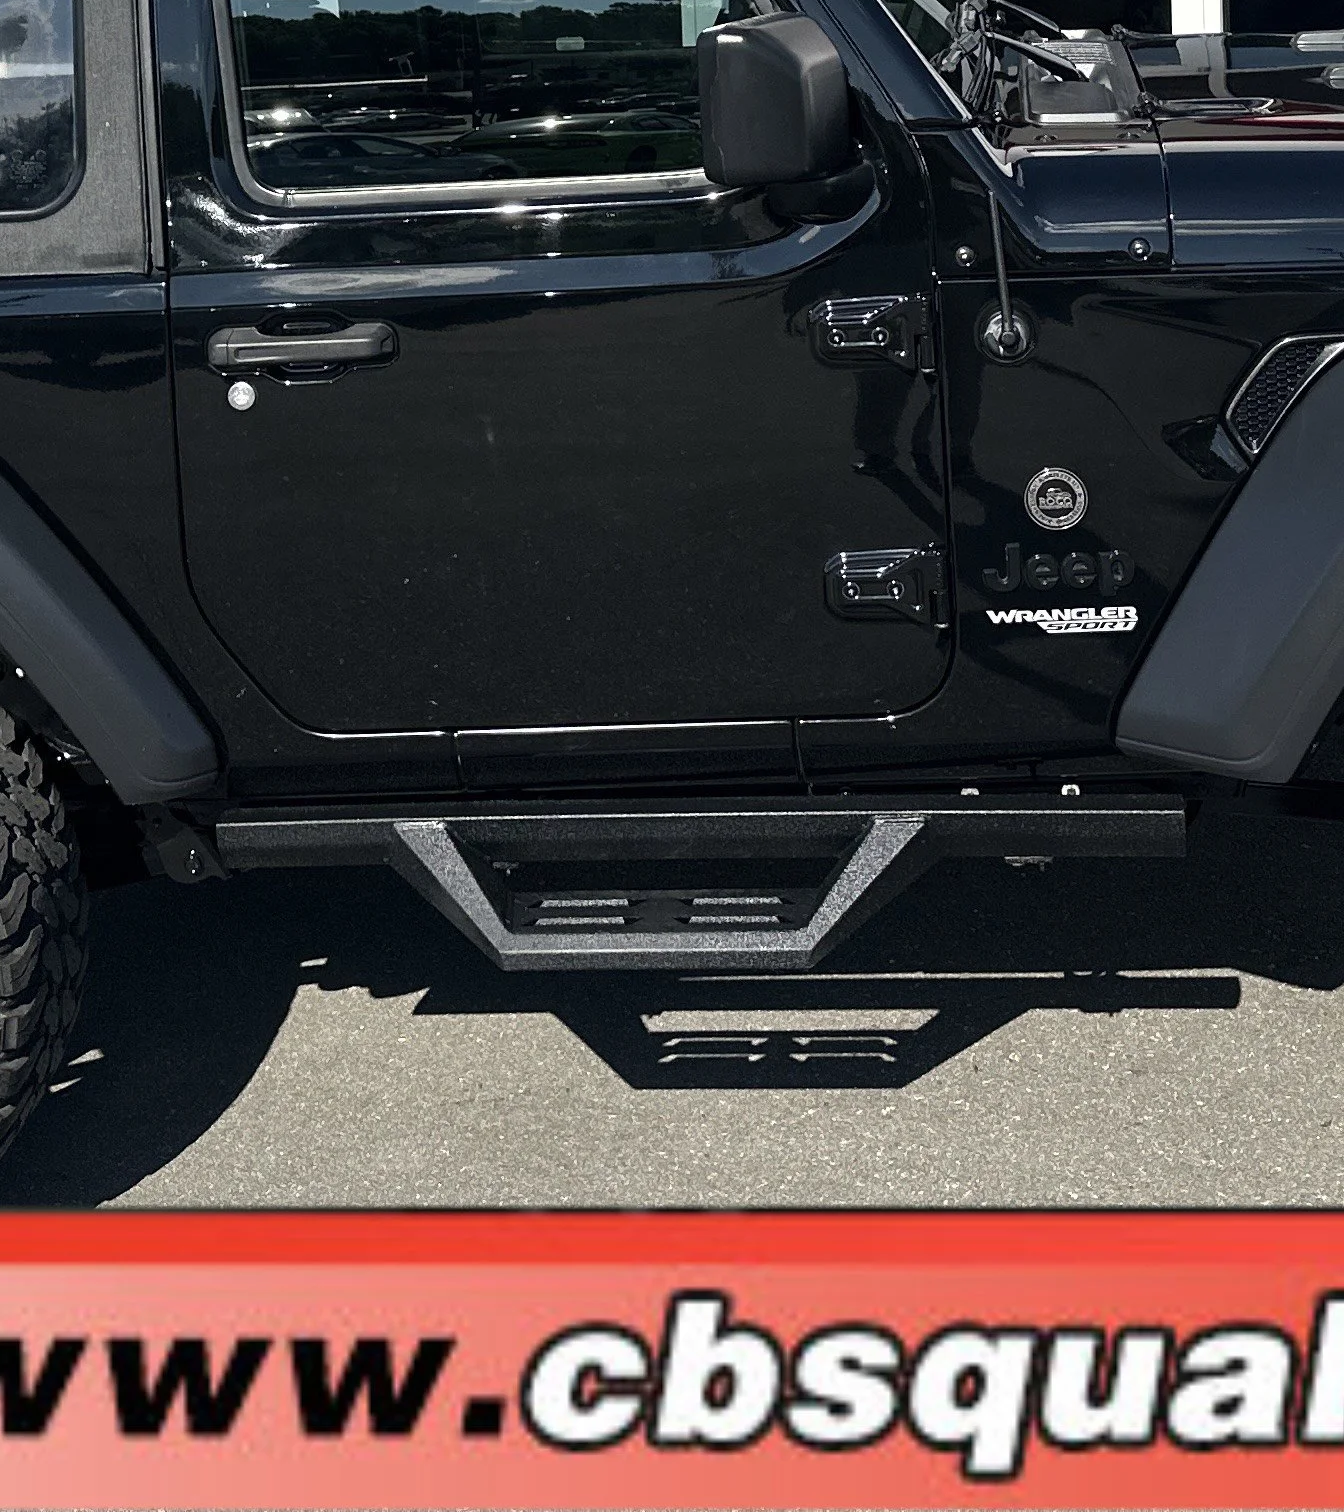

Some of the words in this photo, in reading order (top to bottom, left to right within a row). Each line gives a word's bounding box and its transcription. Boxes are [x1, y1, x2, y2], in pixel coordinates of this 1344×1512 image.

[982, 542, 1136, 597] Jeep
[986, 606, 1138, 624] WRANGLER
[1045, 620, 1135, 632] SPORT
